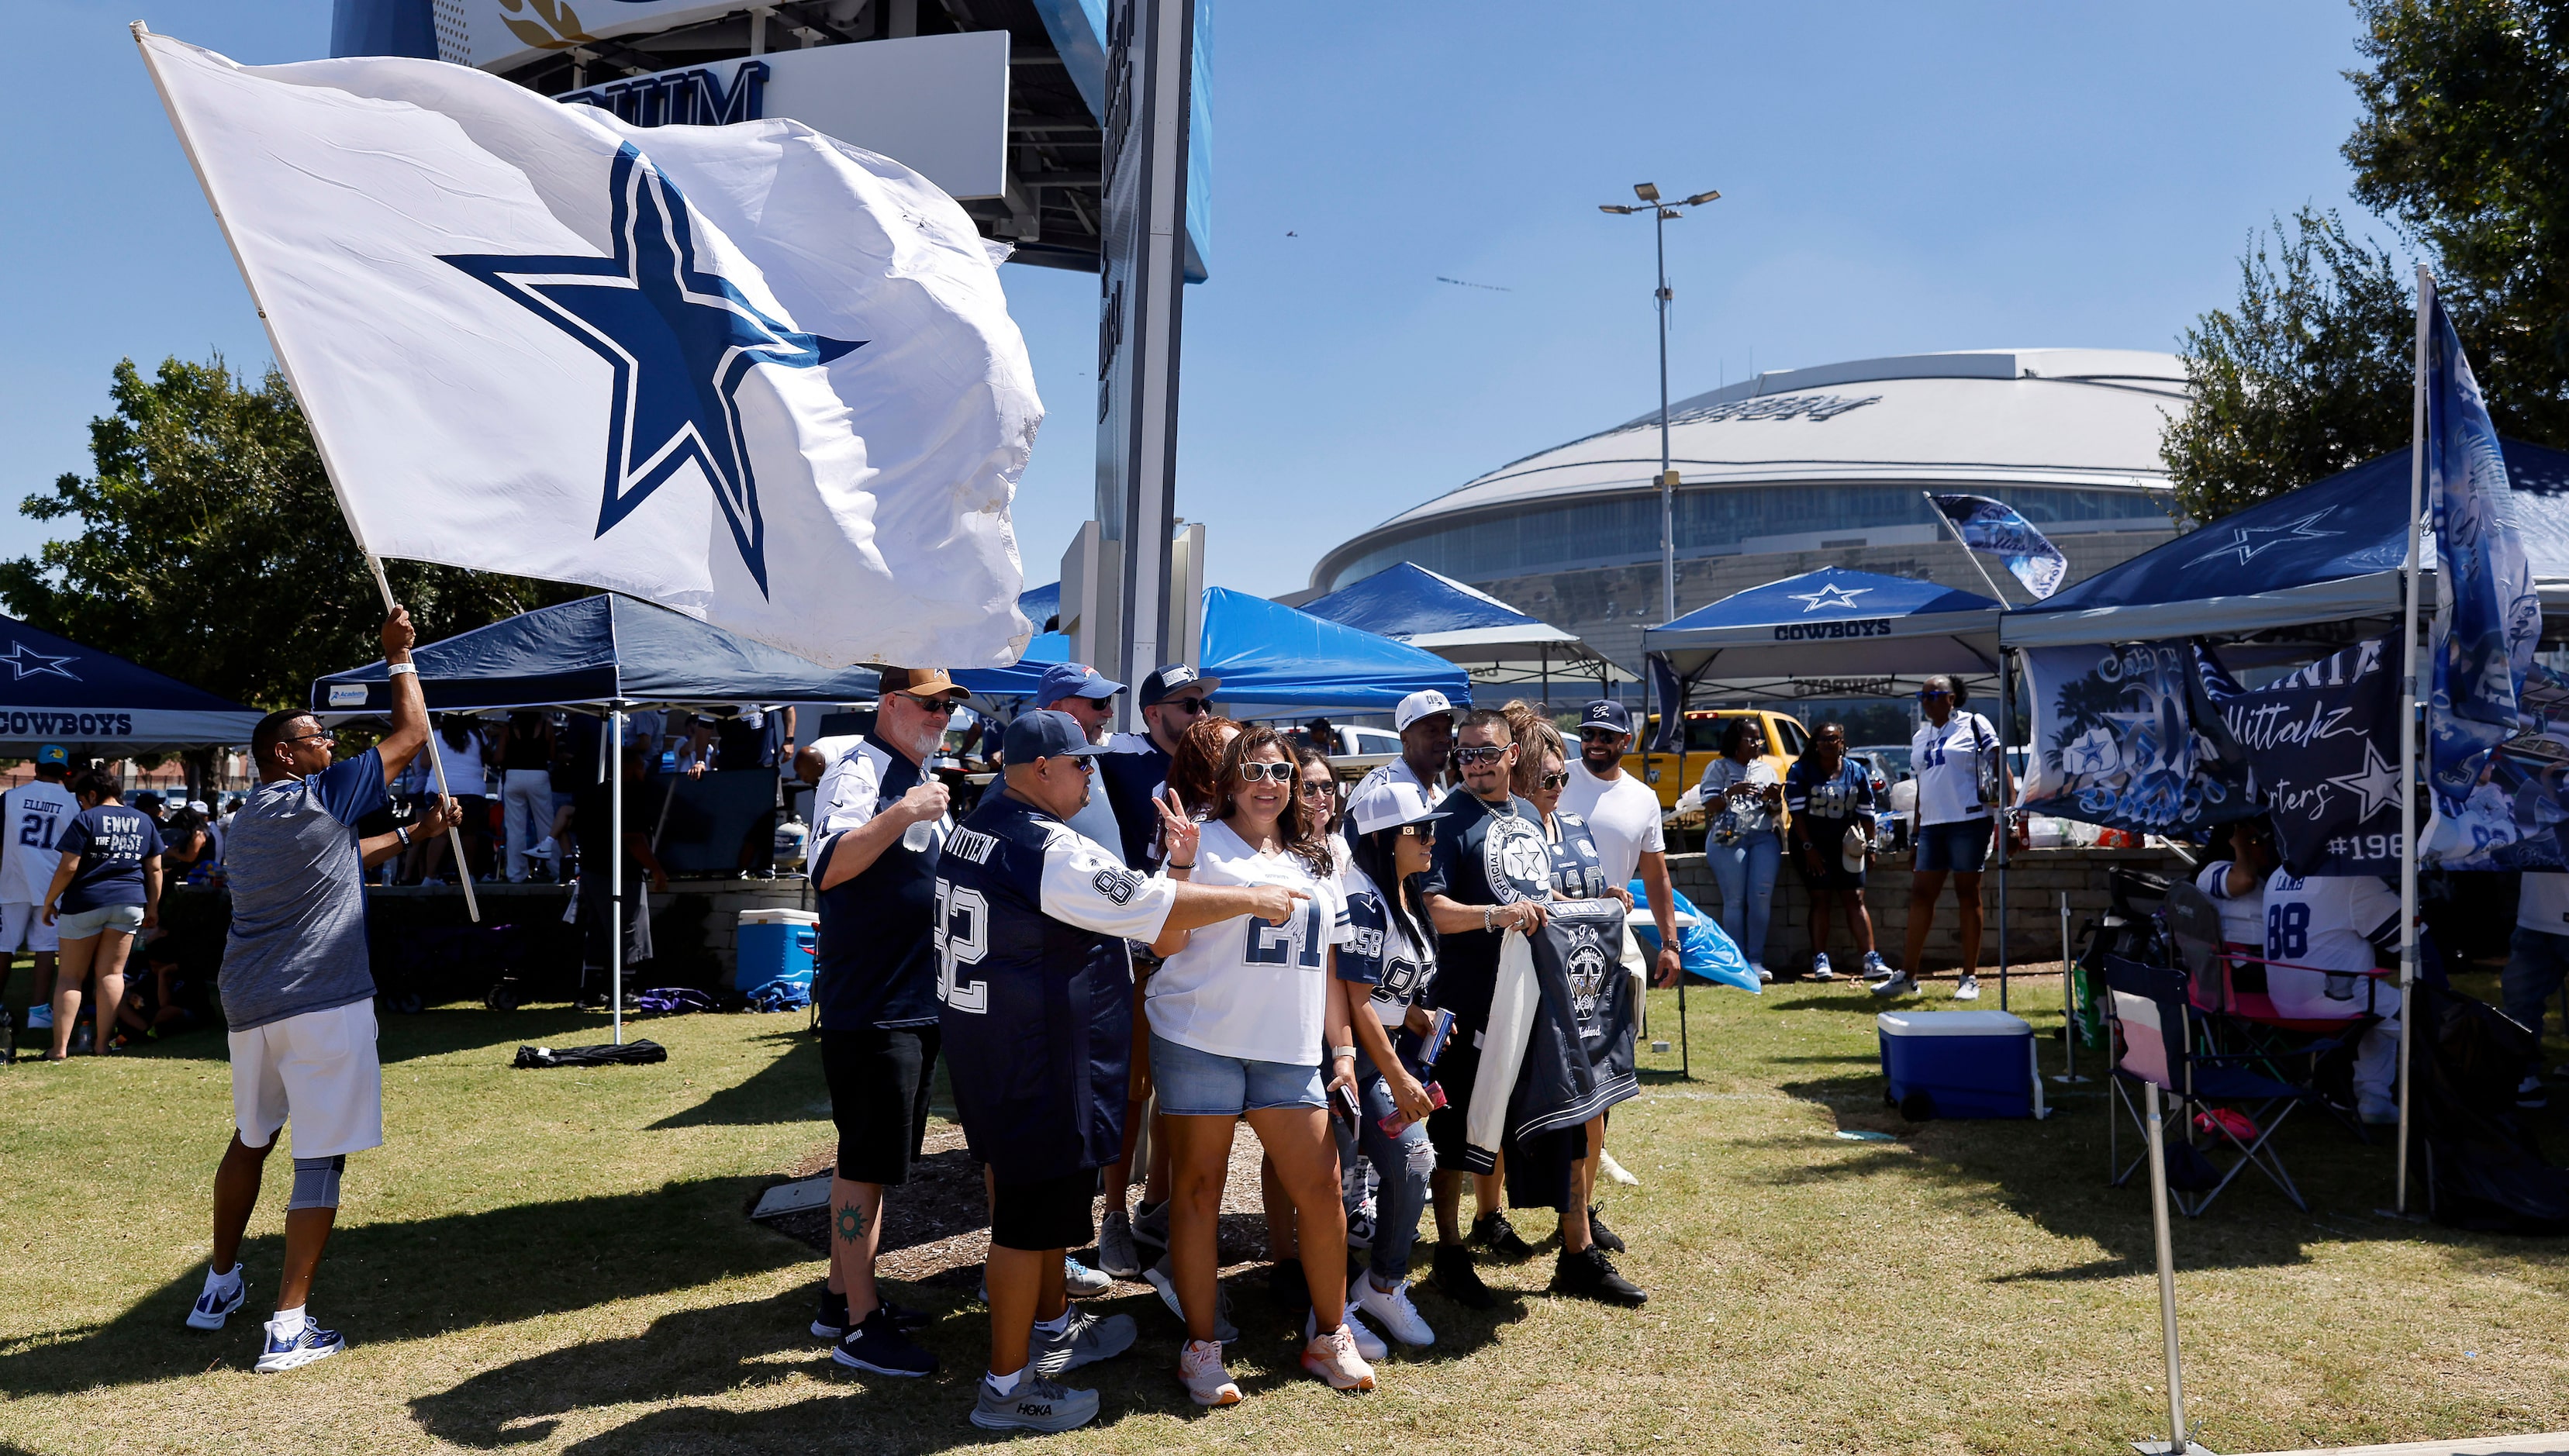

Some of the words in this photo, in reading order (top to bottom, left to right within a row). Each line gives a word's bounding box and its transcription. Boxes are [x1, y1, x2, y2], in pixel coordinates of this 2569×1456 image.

[1774, 619, 1891, 640] COWBOYS
[23, 799, 64, 814] ELLIOTT
[19, 813, 58, 850] 21
[102, 816, 140, 833] ENVY
[95, 837, 110, 846] THE
[110, 833, 143, 851] PAST
[1490, 851, 1510, 896] OFFICIAL
[1552, 900, 1601, 915] COWBOYS
[1241, 882, 1321, 971] 21
[2267, 902, 2311, 961] 88
[845, 1329, 863, 1344] PUMA
[1017, 1403, 1052, 1416] HOKA
